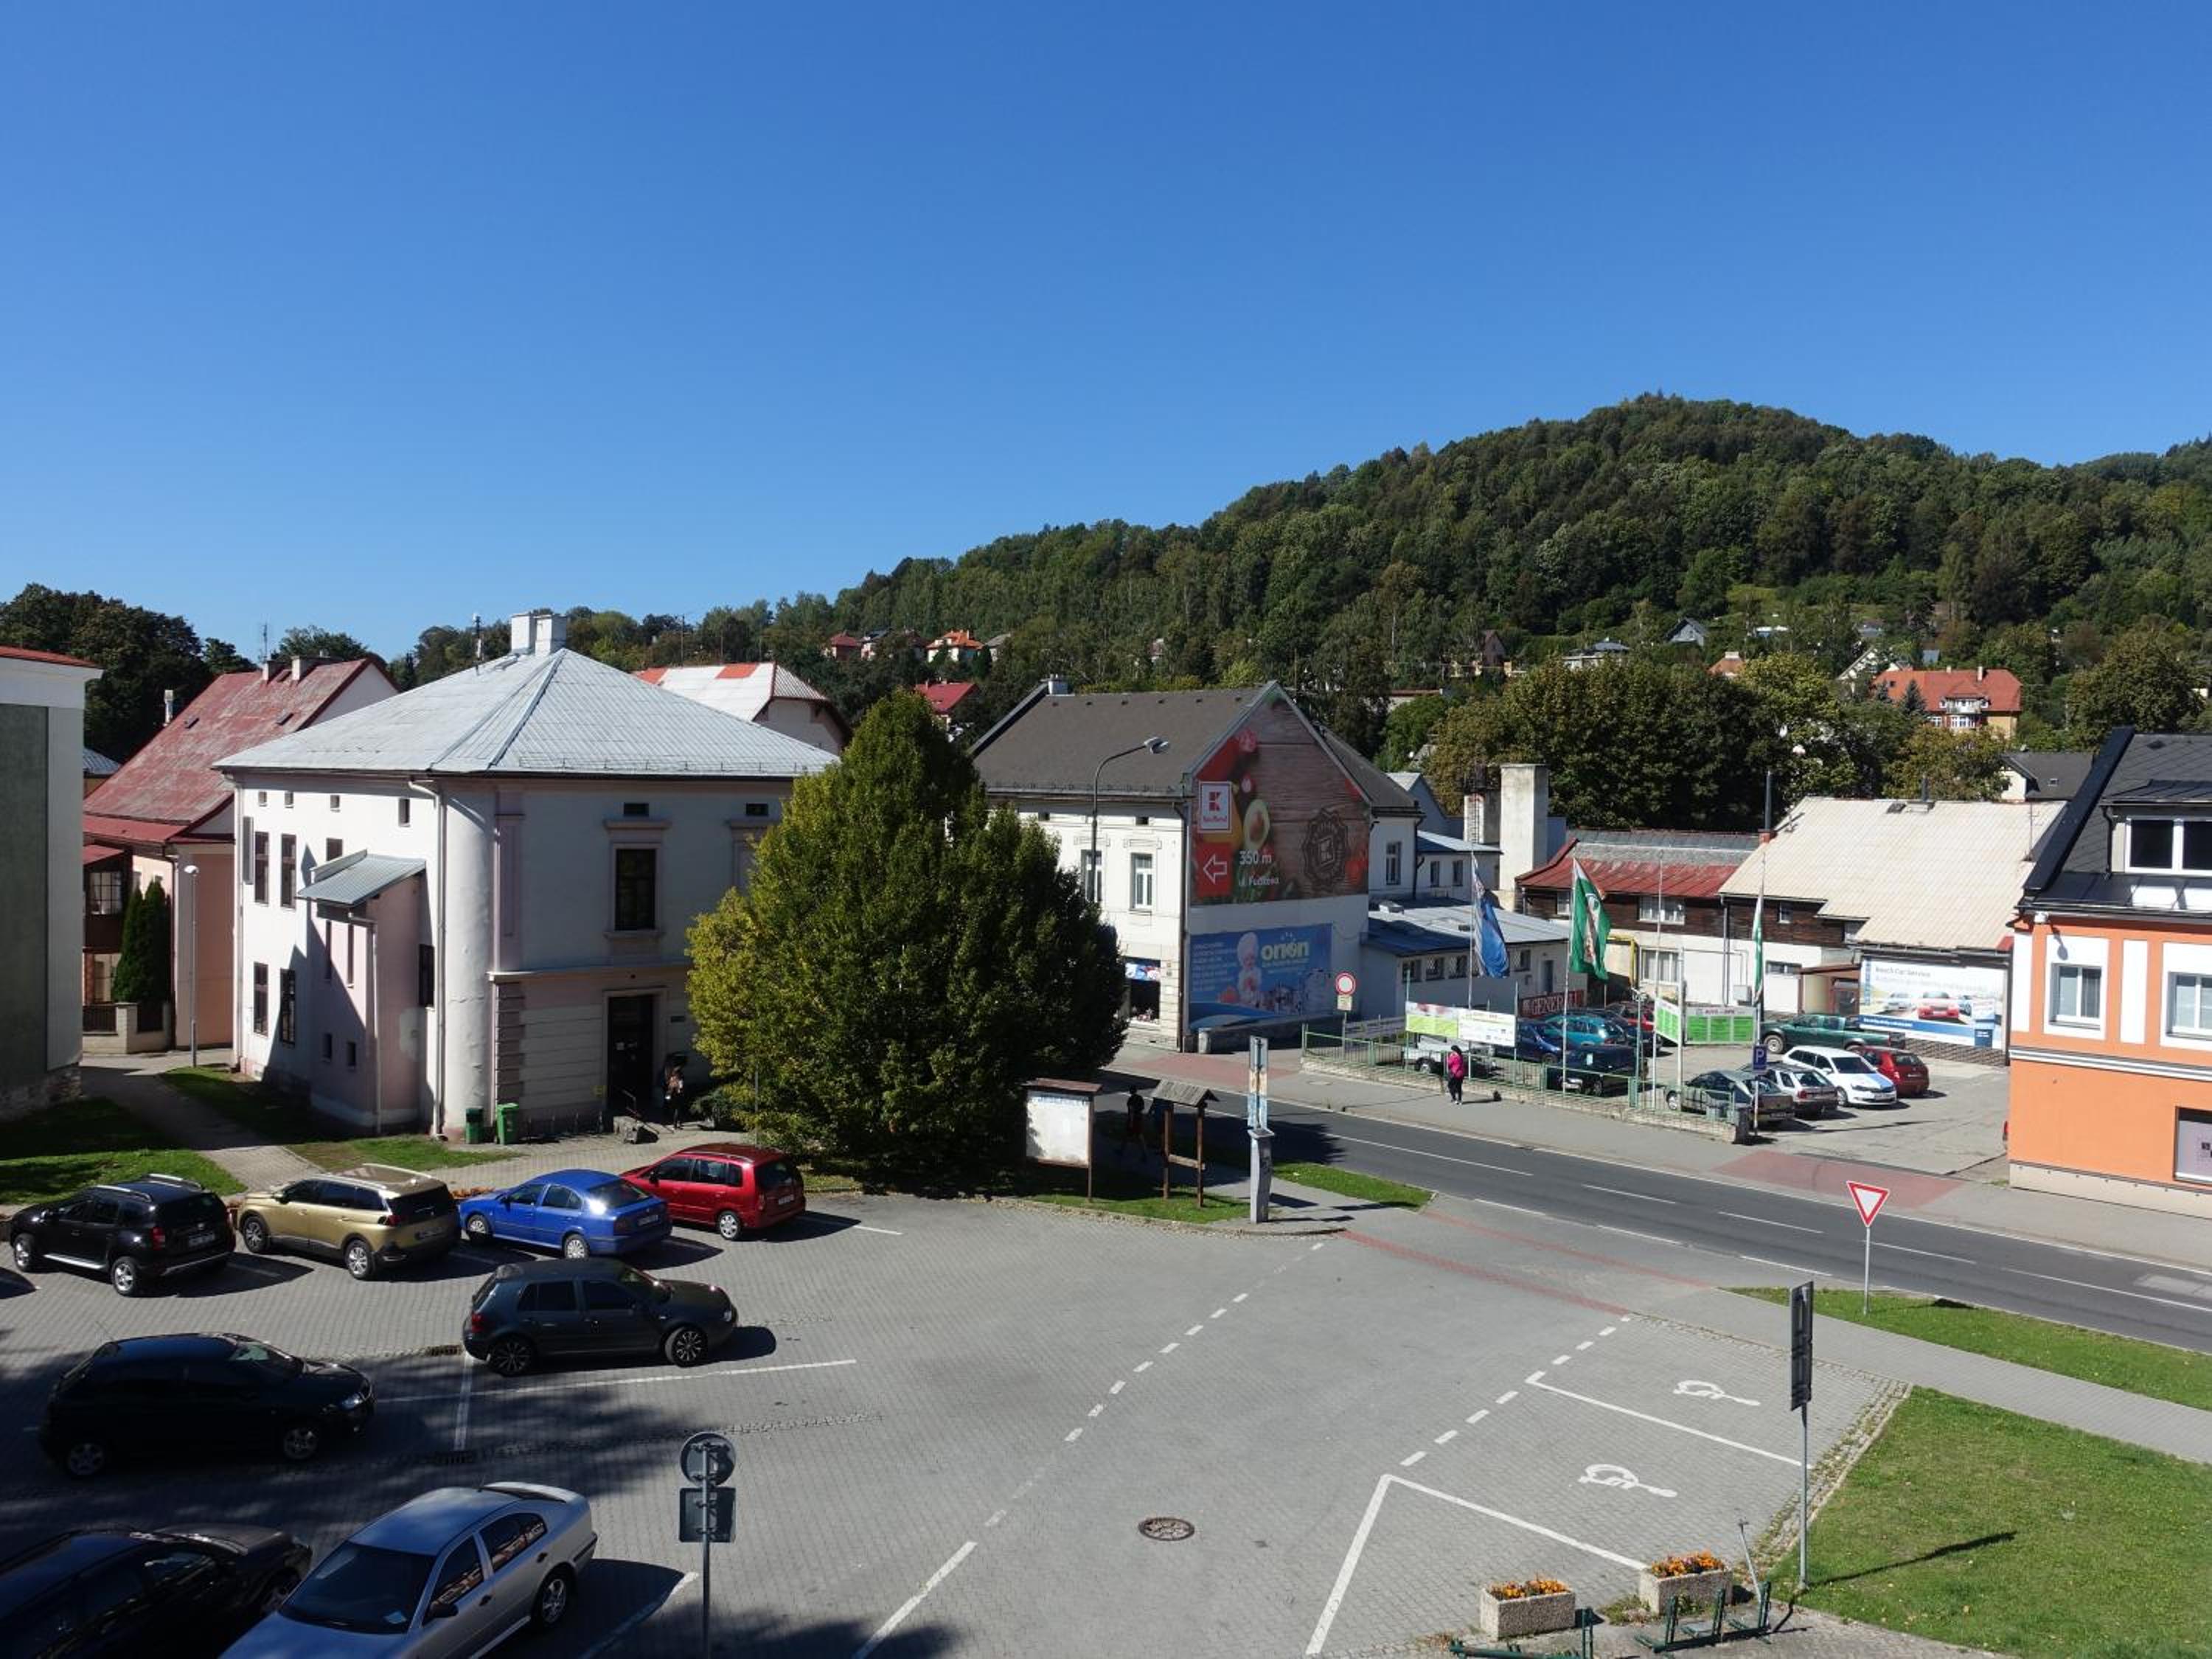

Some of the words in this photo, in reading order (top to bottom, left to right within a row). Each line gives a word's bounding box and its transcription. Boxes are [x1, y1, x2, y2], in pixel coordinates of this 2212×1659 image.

[1239, 850, 1259, 865] 350
[1262, 855, 1272, 864] m
[1756, 1048, 1764, 1062] P
